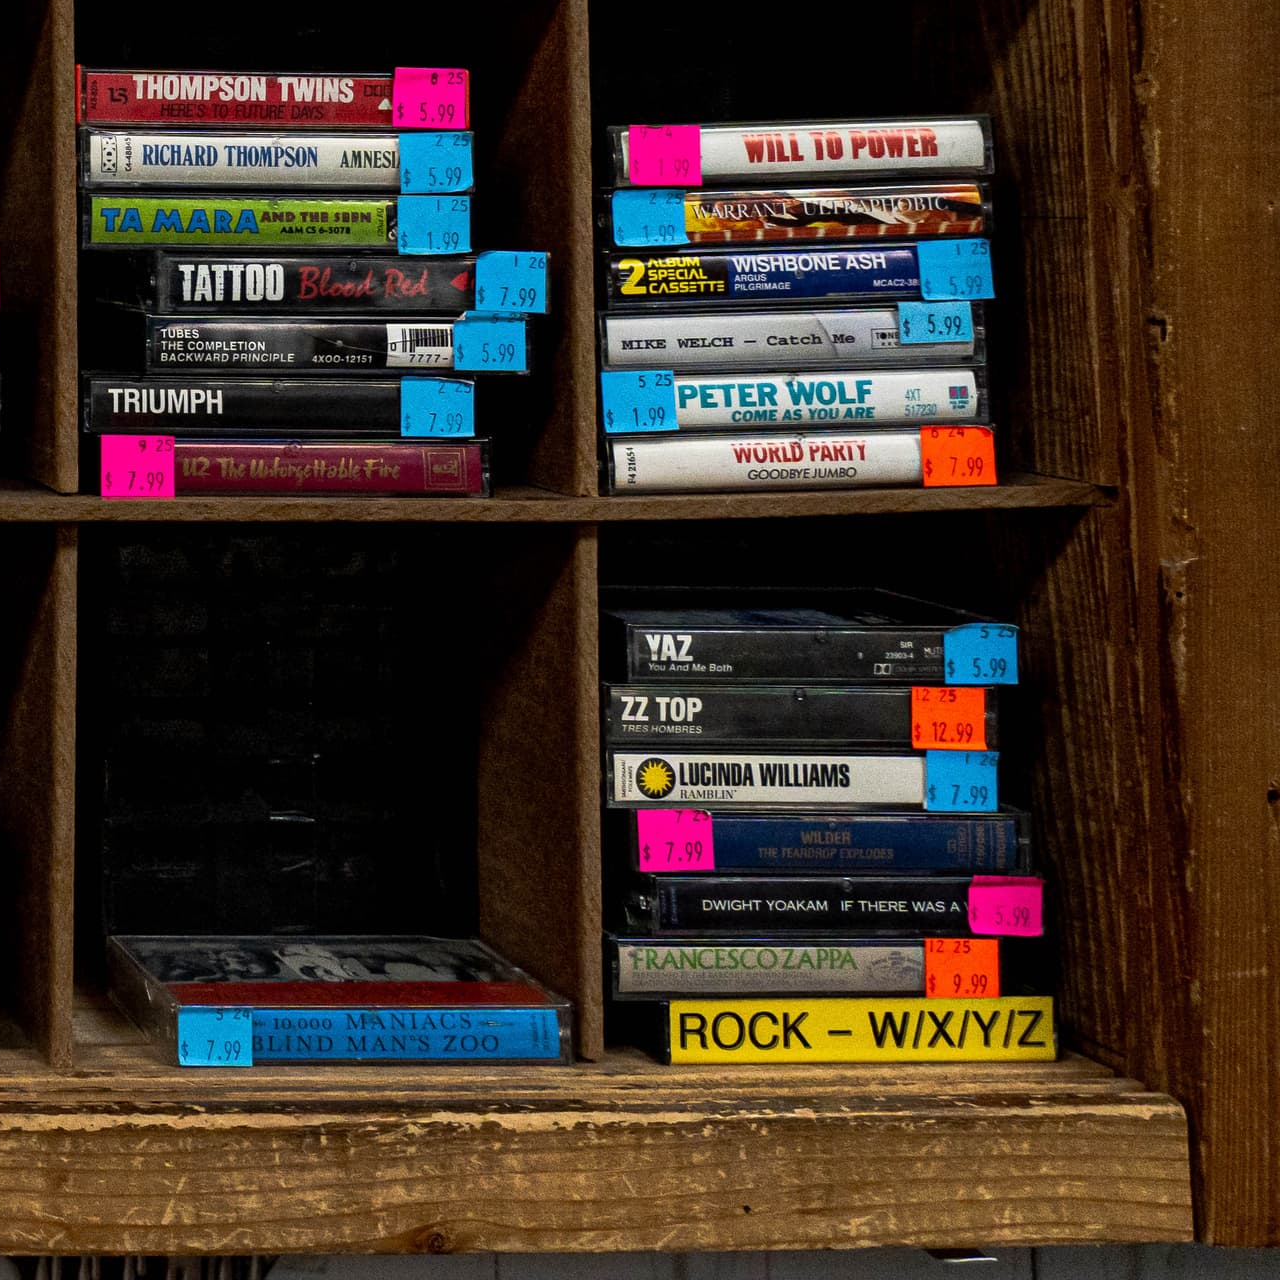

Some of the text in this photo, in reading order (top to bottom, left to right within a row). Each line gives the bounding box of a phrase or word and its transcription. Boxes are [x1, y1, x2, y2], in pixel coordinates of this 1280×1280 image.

[133, 75, 354, 103] THOMPSON TWINS
[142, 145, 318, 168] RICHARD THOMPSON
[742, 128, 938, 163] WILL TO POWER
[732, 254, 887, 273] WISHBONE ASH
[179, 264, 284, 302] TATTOO
[622, 337, 733, 350] MIKE WELCH
[108, 389, 223, 415] TRIUMPH
[678, 380, 872, 408] PETER WOLF
[645, 634, 693, 661] YAZ
[621, 697, 702, 722] ZZ TOP
[622, 724, 702, 734] TRES HOMBRES
[932, 722, 972, 743] 12.99
[679, 763, 850, 787] LUCINDA WILLIAMS
[702, 900, 828, 912] DWIGHT YOAKAM
[345, 1013, 472, 1030] MANIACS
[680, 1009, 1046, 1049] ROCK W/X/Y/Z
[443, 1035, 499, 1052] ZOO
